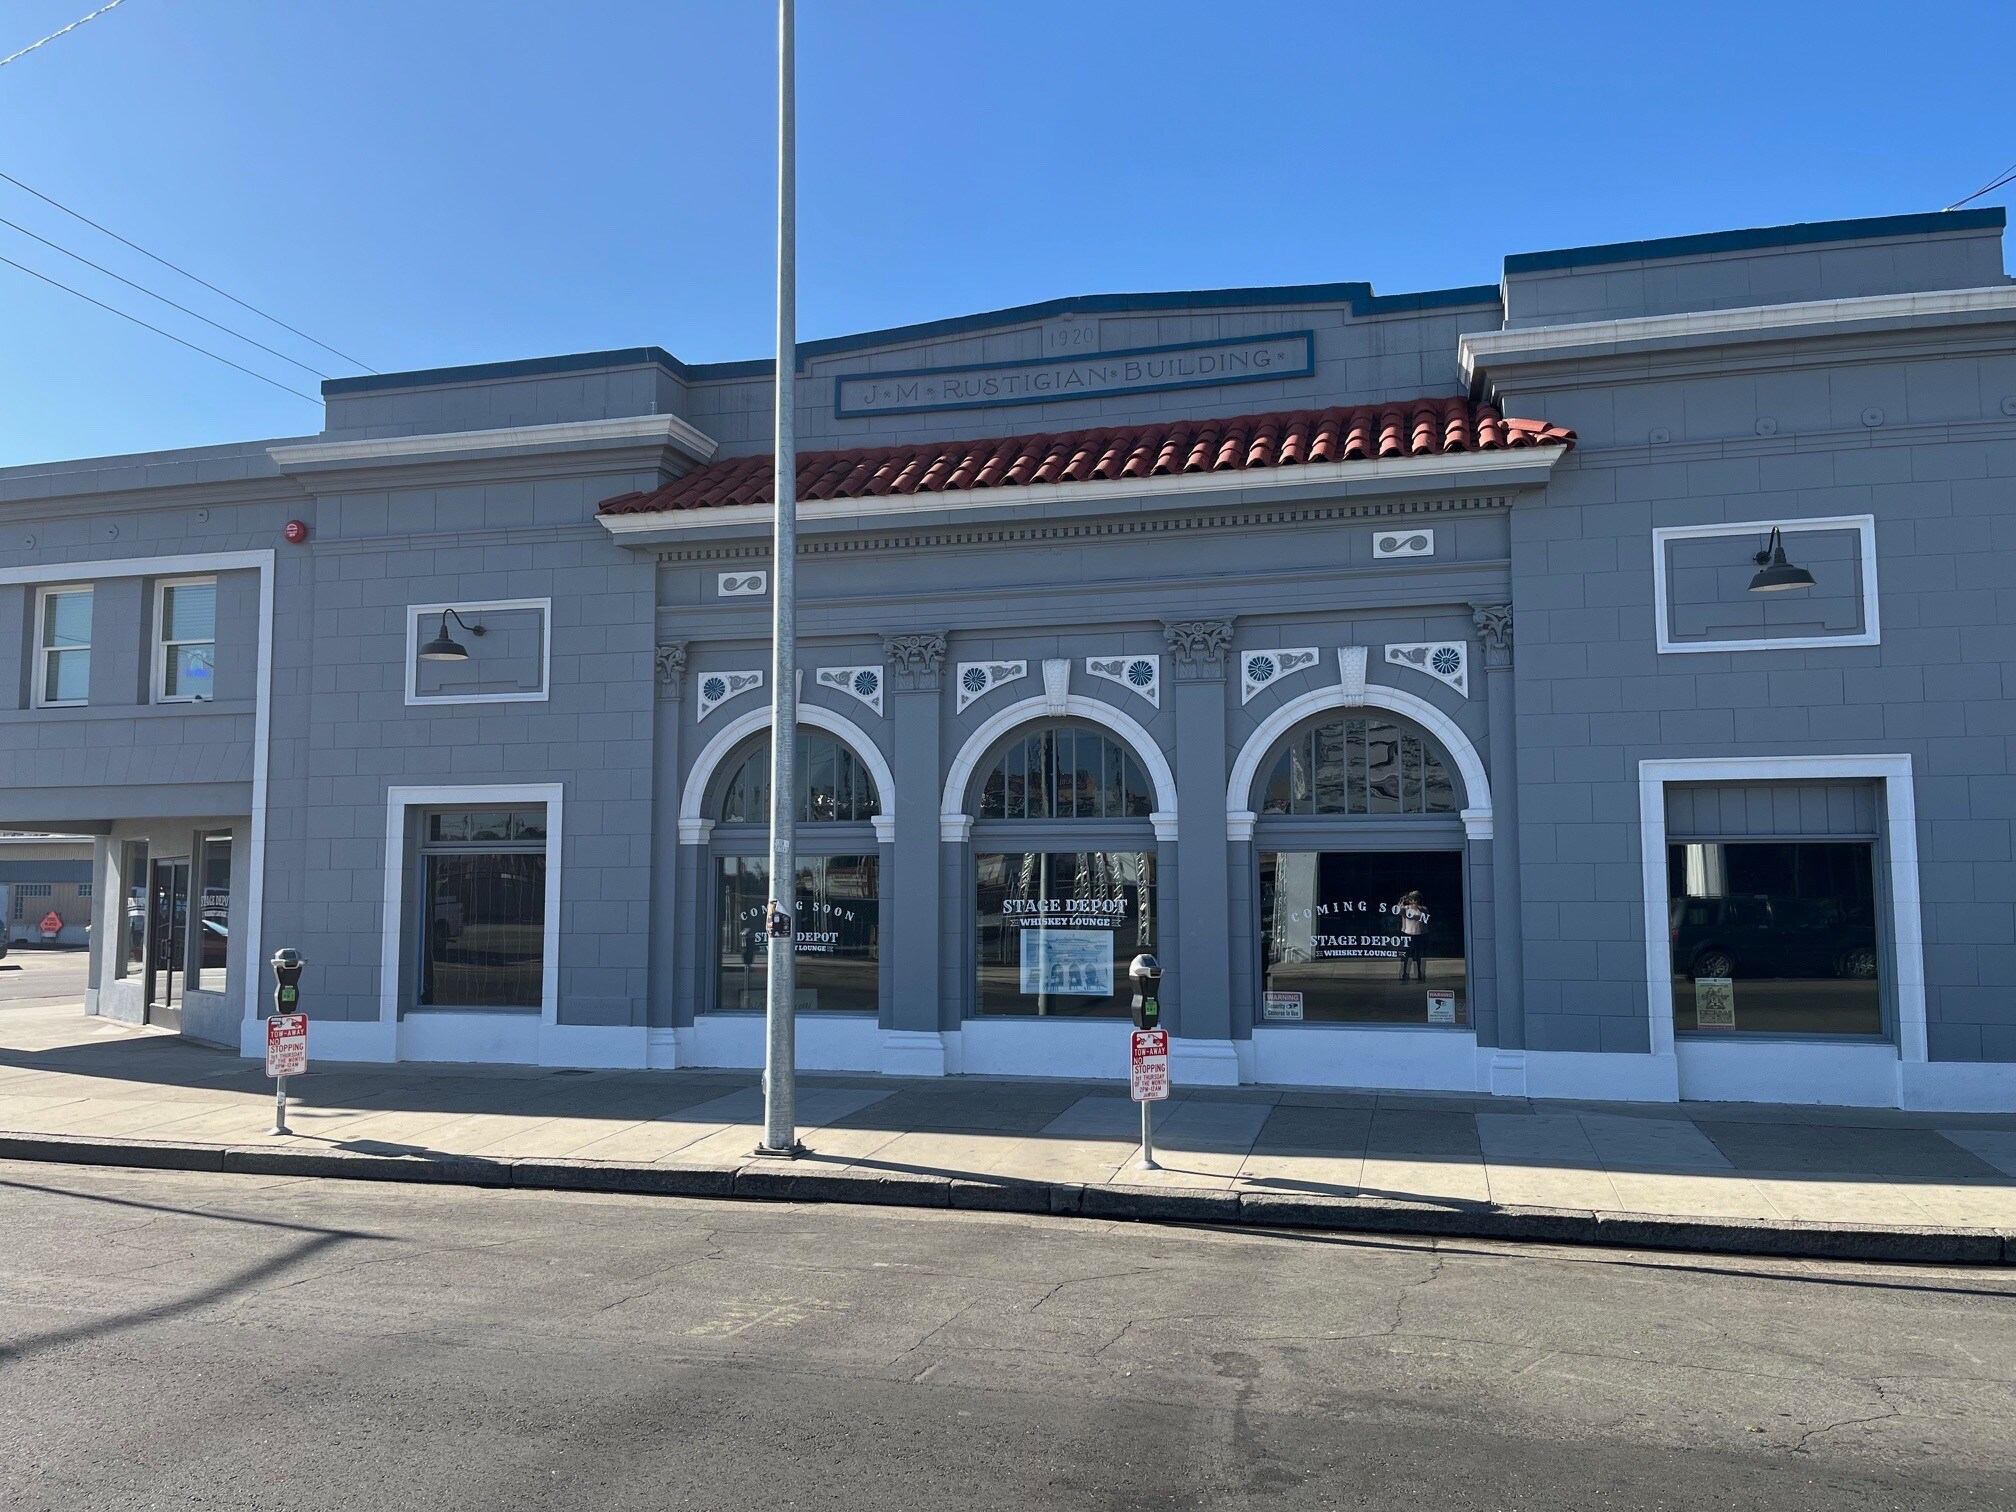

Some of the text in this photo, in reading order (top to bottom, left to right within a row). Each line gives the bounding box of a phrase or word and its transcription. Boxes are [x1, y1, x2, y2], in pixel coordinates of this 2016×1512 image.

[1051, 327, 1093, 348] 1920
[896, 382, 919, 402] M
[942, 367, 1109, 399] RUSTIGIAN
[1124, 349, 1272, 382] BUILDING
[216, 895, 230, 906] DEPO
[1002, 898, 1128, 914] STAGE DEPOT
[812, 901, 856, 922] SOON
[1290, 900, 1432, 925] COMING SOON
[1020, 917, 1111, 927] WHISKEY LOUNGE
[796, 932, 839, 943] DEPOT
[1309, 935, 1412, 947] STAGE DEPOT
[1323, 949, 1398, 958] WHISKEY LOUNGE
[271, 1029, 305, 1038] TOW-AWAY
[270, 1038, 280, 1046] NO
[271, 1043, 304, 1053] STOPPING
[1134, 1047, 1165, 1056] TOW-AWAY
[1133, 1056, 1143, 1065] NO
[1134, 1063, 1165, 1074] STOPPING
